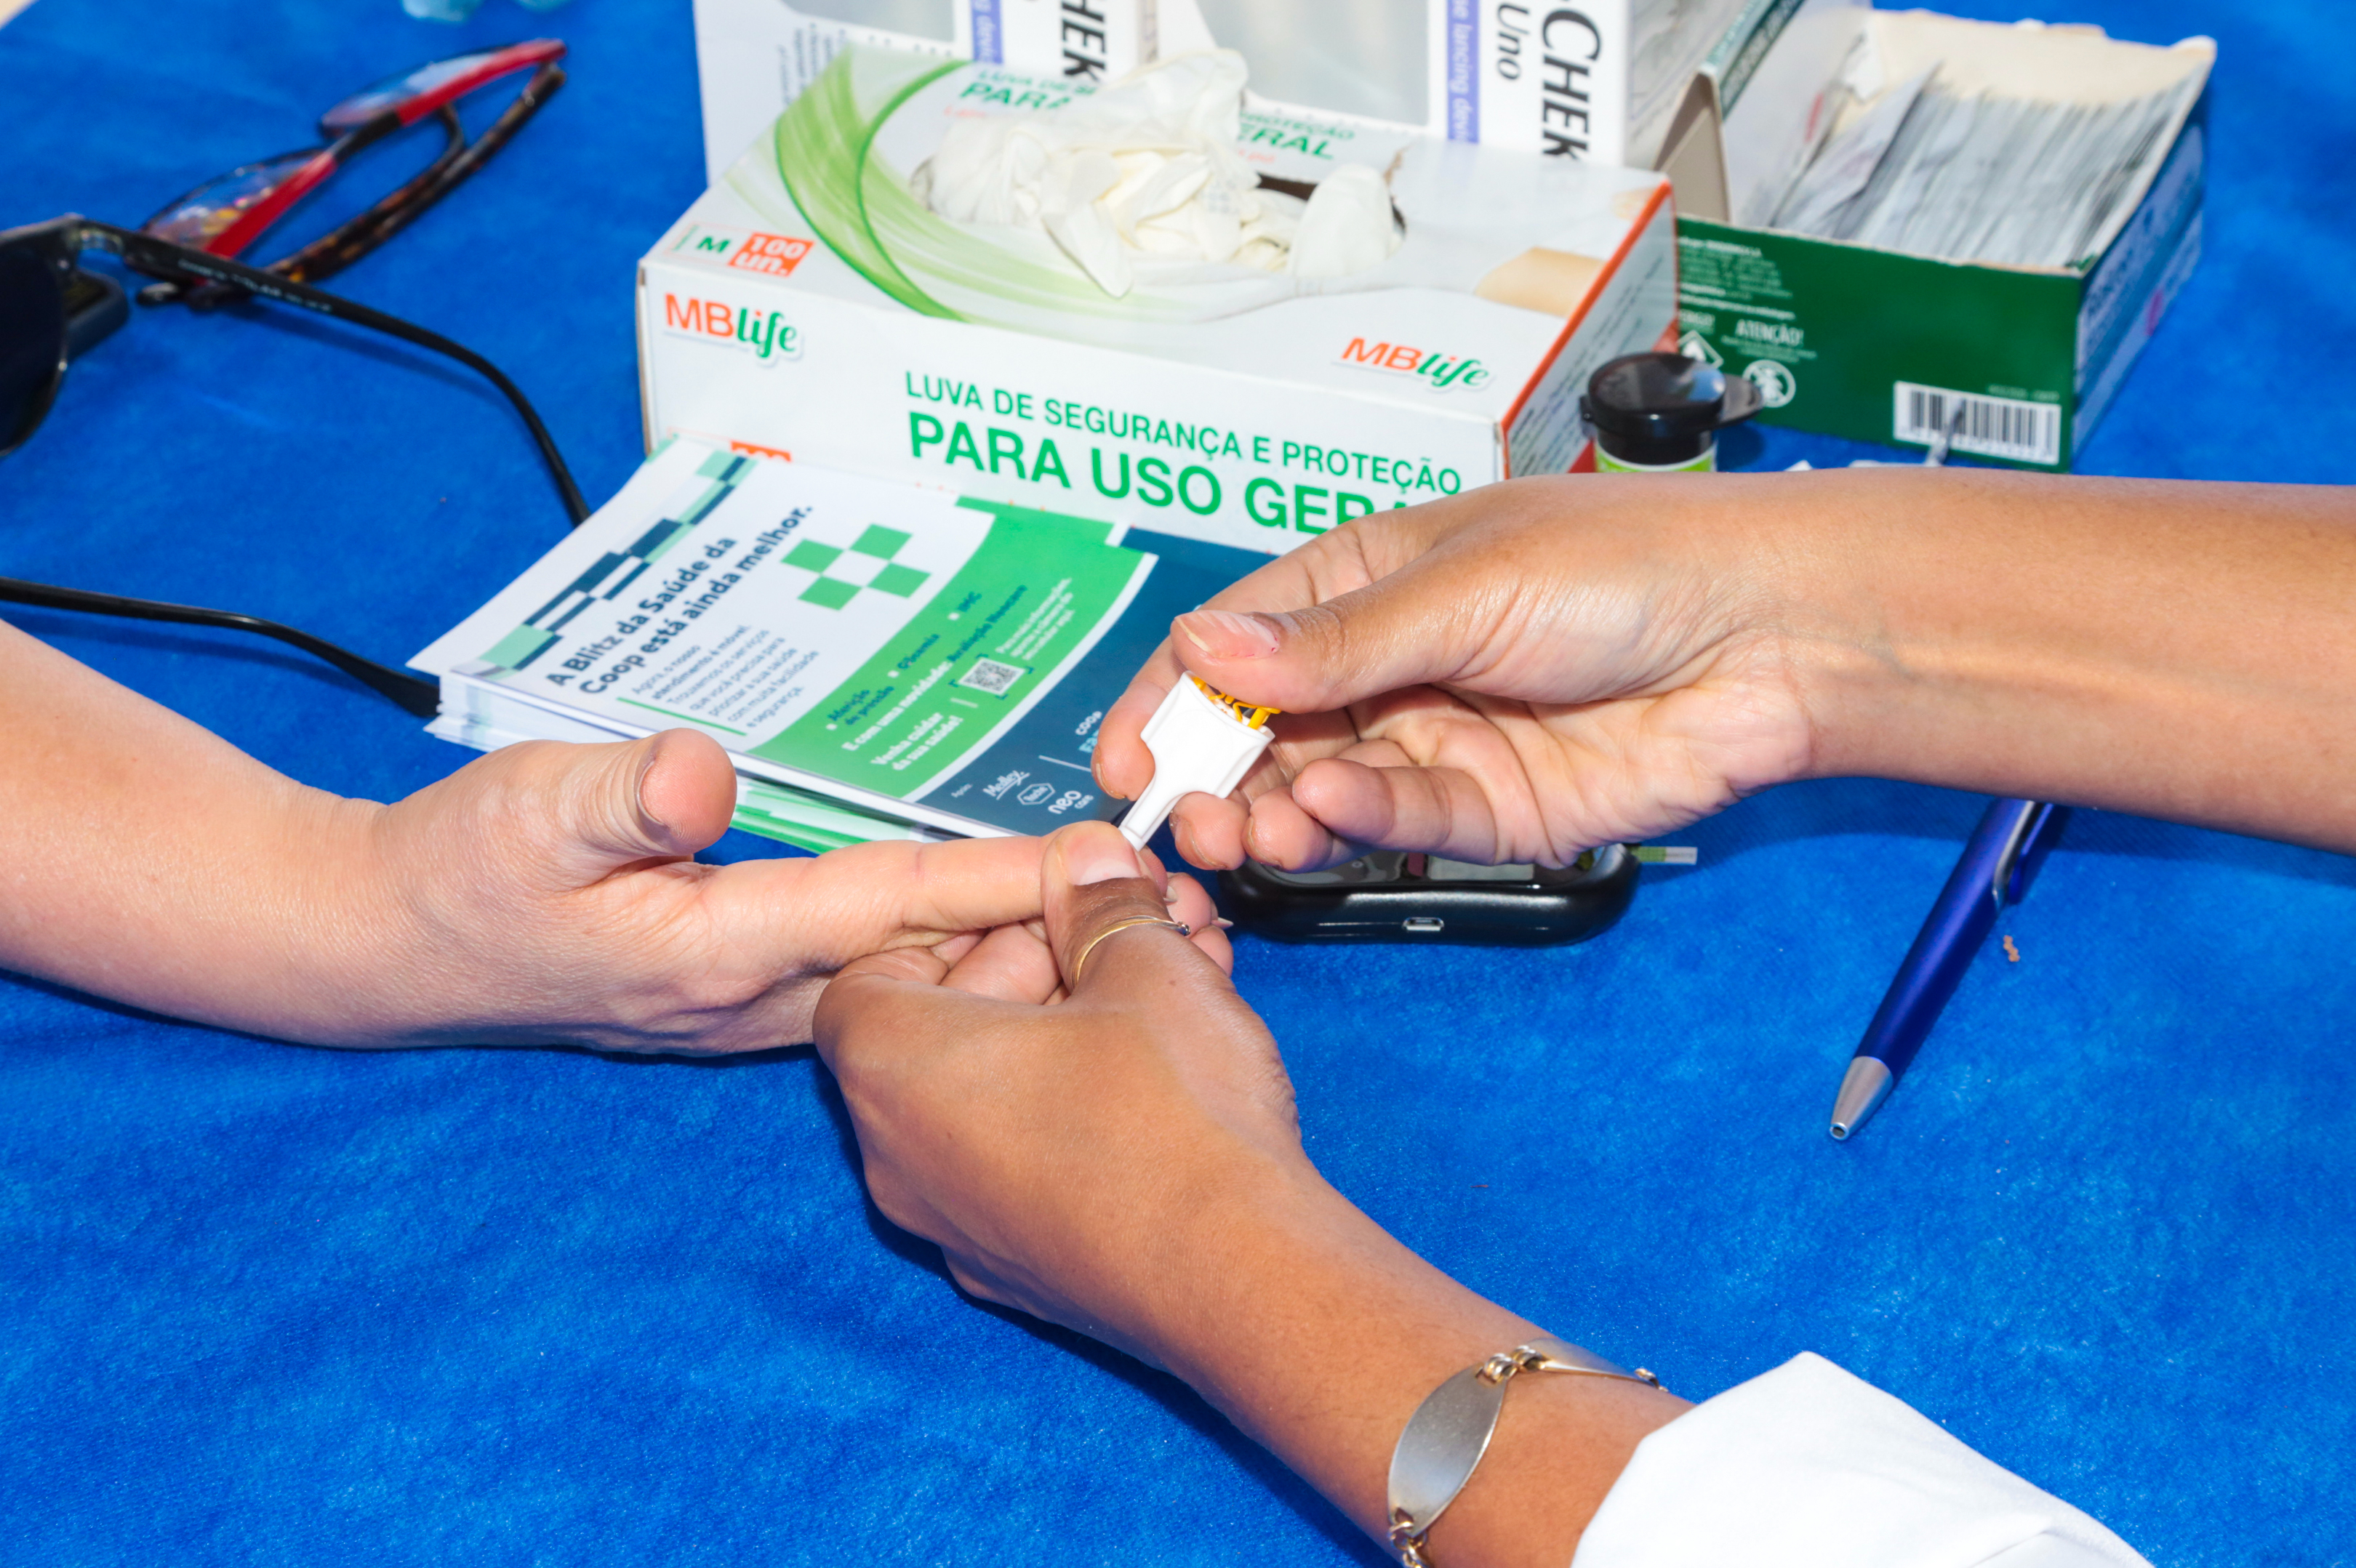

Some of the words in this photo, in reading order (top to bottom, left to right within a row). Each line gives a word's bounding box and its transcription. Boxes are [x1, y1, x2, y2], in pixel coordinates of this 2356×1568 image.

[1449, 23, 1473, 95] lancing
[1496, 3, 1530, 81] Uno
[1238, 123, 1334, 161] ERAL
[697, 236, 730, 254] M
[750, 236, 806, 259] 100
[665, 293, 797, 358] MBlife
[1341, 337, 1489, 387] MBlife
[906, 371, 983, 411] LUVA
[994, 388, 1033, 420] DE
[1044, 398, 1242, 461] SEGURANÇA
[1253, 436, 1271, 463] E
[1283, 441, 1462, 496] PROTEÇÃO
[910, 411, 1072, 489] PARA
[1091, 447, 1221, 515] USO
[1244, 477, 1407, 536] GER
[546, 672, 576, 686] A
[562, 636, 624, 672] Blitz
[617, 614, 650, 636] da
[638, 560, 710, 613] Saúde
[705, 537, 737, 559] da
[580, 654, 646, 694] Coop
[640, 618, 689, 655] está
[682, 572, 741, 619] ainda
[735, 506, 813, 572] melhor.
[652, 656, 713, 699] atendimento
[718, 624, 752, 650] móvel.
[666, 668, 723, 704] Trouxemos
[720, 659, 734, 669] os
[731, 630, 769, 659] serviços
[670, 645, 701, 667] nosso
[689, 696, 710, 710] que
[710, 680, 732, 697] você
[729, 654, 764, 683] precisa
[761, 637, 785, 655] para
[709, 689, 746, 717] priorizar
[752, 671, 771, 685] sua
[768, 648, 798, 670] saúde
[727, 707, 750, 723] com
[748, 686, 777, 707] muita
[771, 651, 820, 686] facilidade
[754, 686, 804, 723] segurança.
[841, 741, 860, 751] E
[854, 725, 882, 744] com
[876, 707, 905, 727] uma
[899, 662, 953, 708] novidade:
[870, 740, 912, 765] Venha
[907, 712, 943, 741] cuidar
[891, 759, 911, 771] da
[906, 745, 929, 760] sua
[925, 715, 963, 747] saúde!
[1048, 790, 1081, 814] neo
